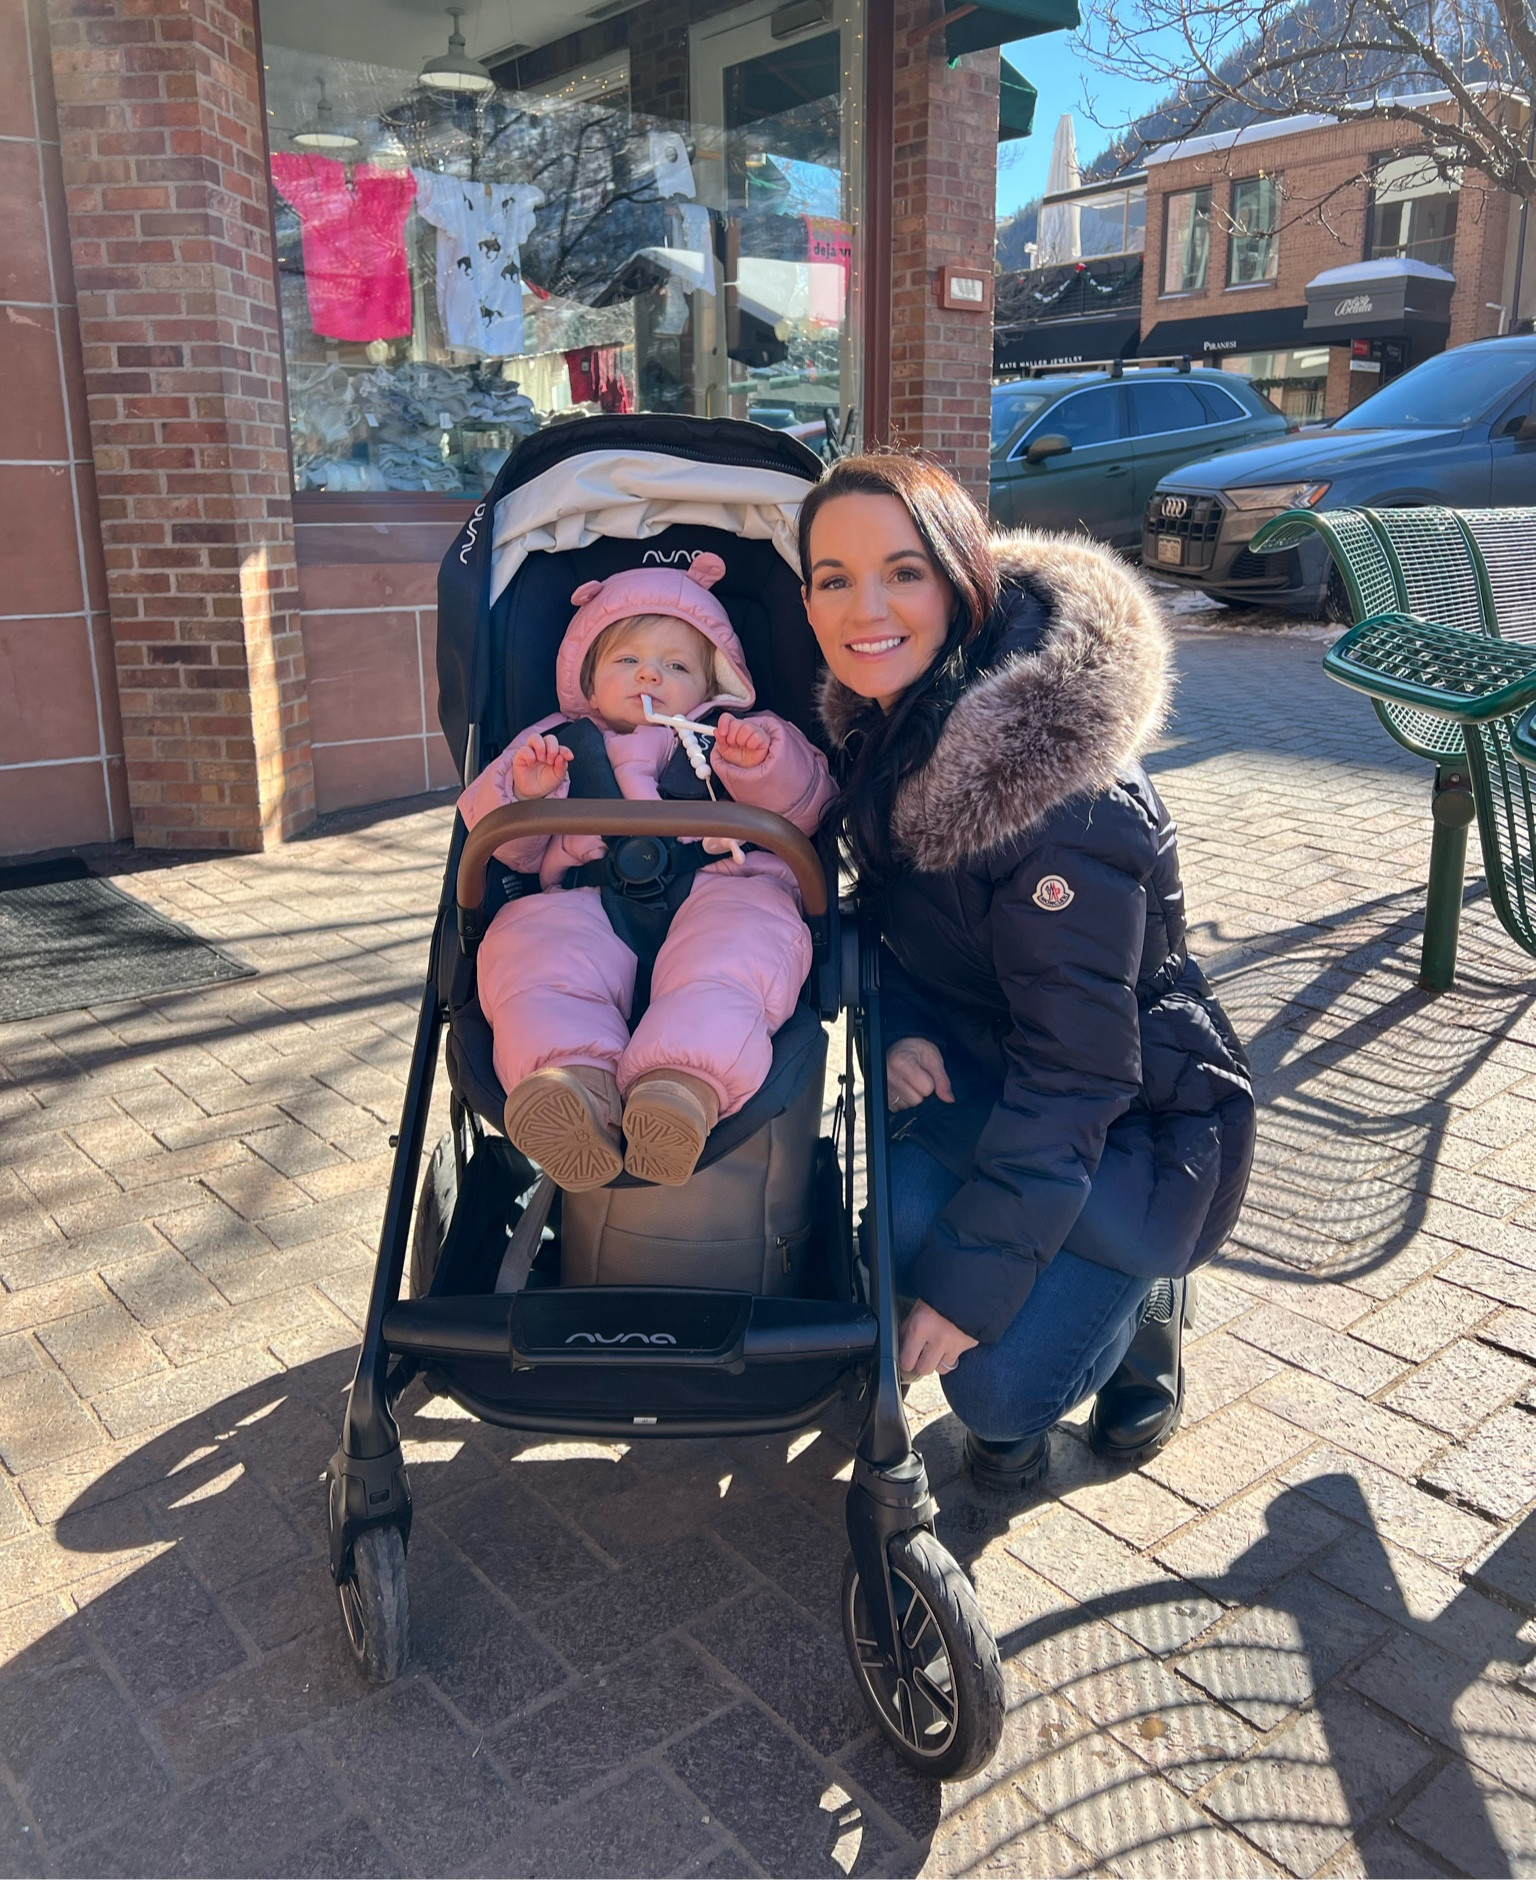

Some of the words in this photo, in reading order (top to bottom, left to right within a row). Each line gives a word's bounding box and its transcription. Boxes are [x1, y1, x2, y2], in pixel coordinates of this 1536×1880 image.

[813, 241, 837, 260] deja
[999, 361, 1017, 370] KATE
[1049, 355, 1083, 364] JEWELRY
[460, 503, 487, 565] nuna
[565, 1332, 677, 1345] nuna
